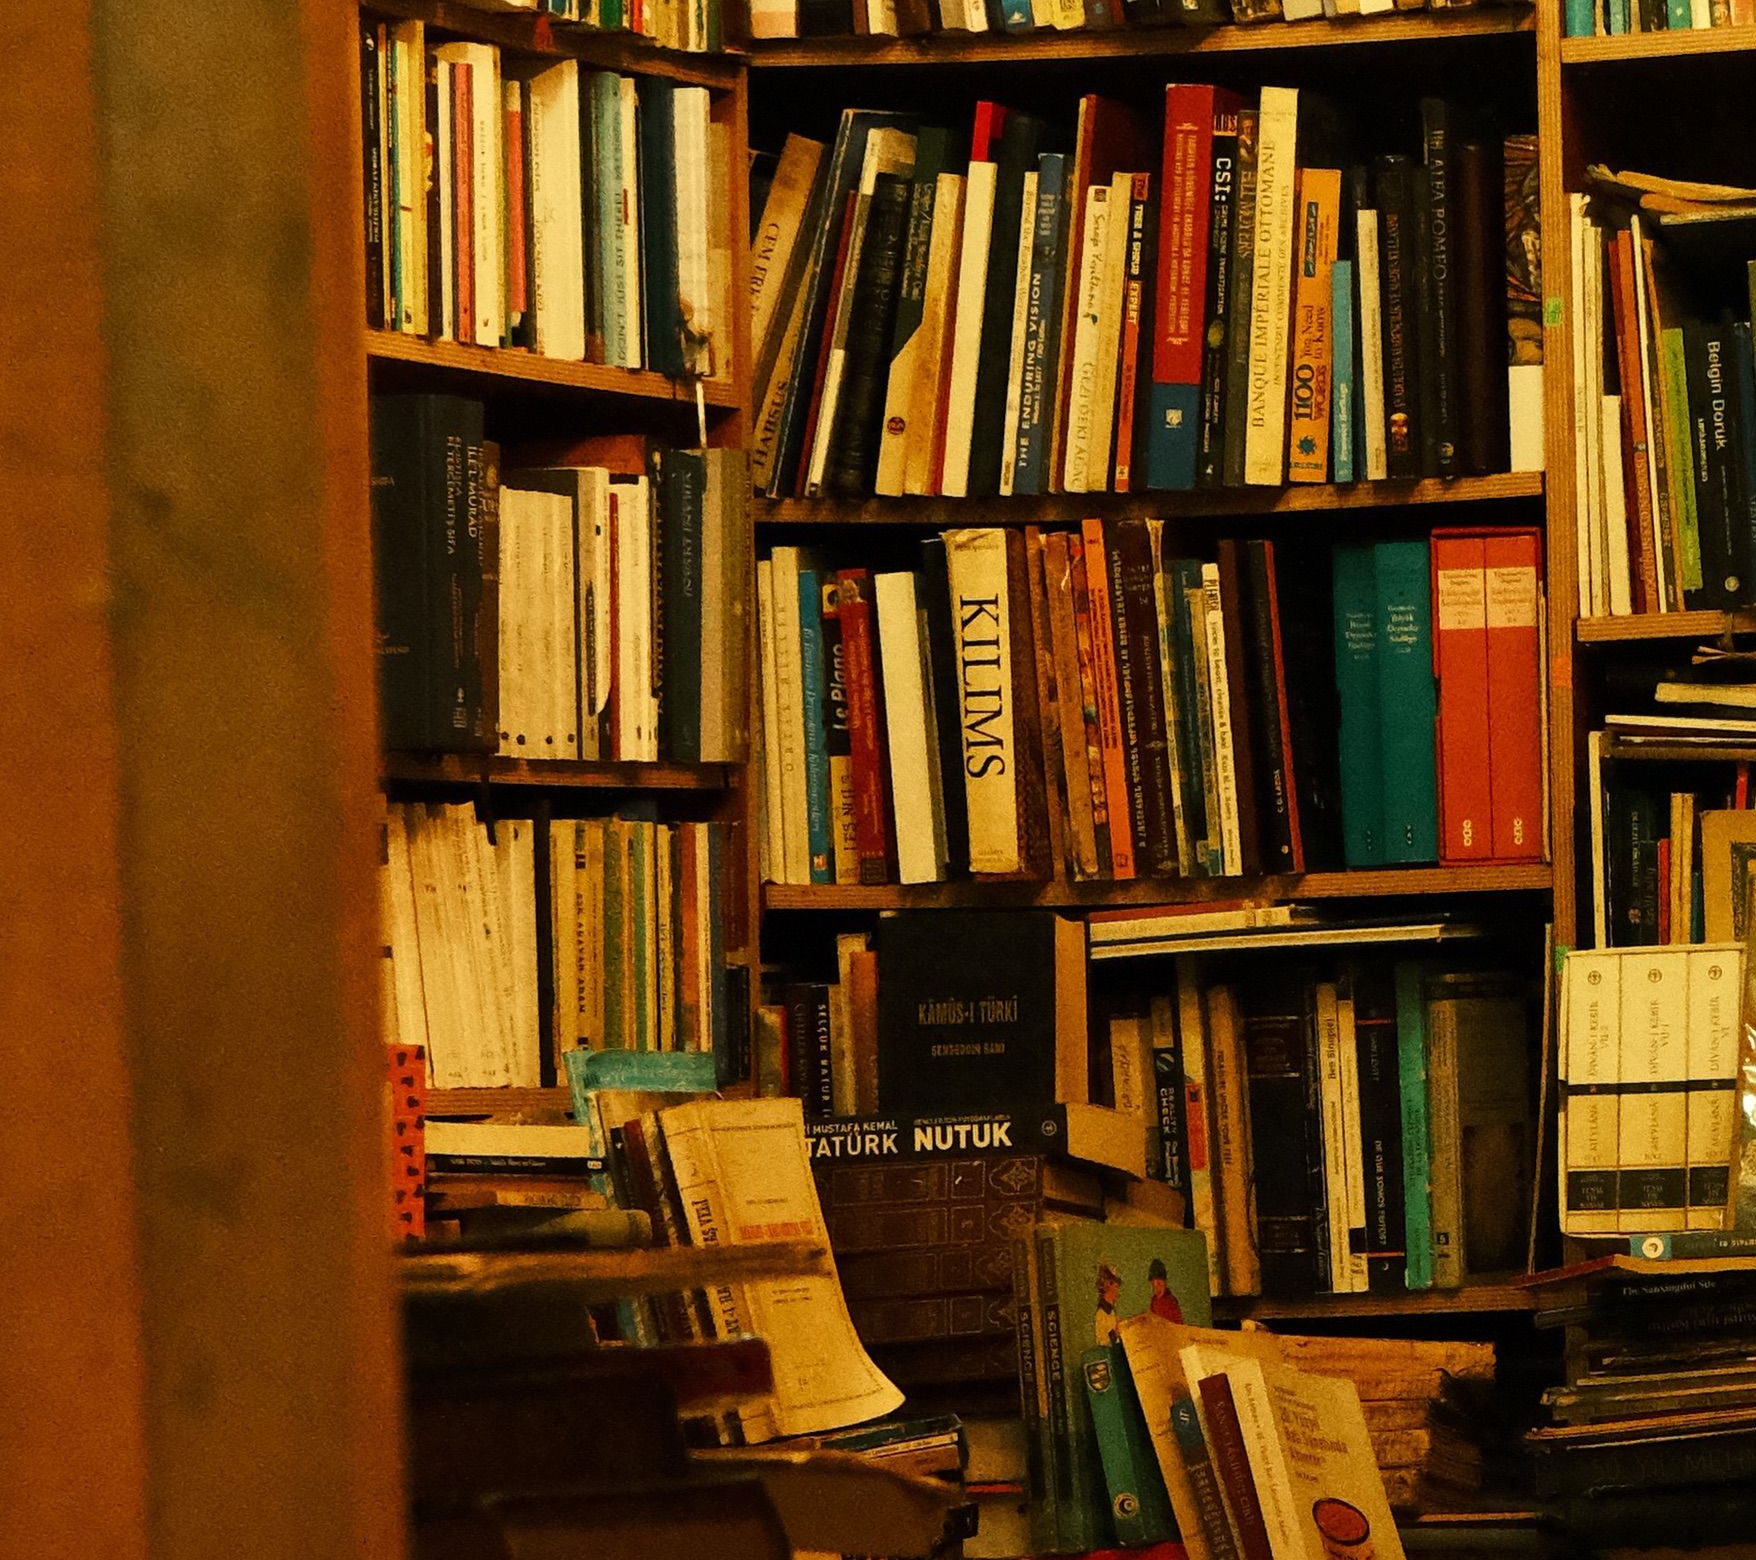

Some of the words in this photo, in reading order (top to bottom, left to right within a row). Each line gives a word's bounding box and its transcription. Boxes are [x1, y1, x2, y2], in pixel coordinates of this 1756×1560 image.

[1214, 157, 1231, 202] CSI:
[1258, 141, 1276, 242] OTTOMANE
[1431, 159, 1445, 201] ALFA
[1432, 207, 1447, 280] ROMEO
[1028, 272, 1042, 332] VISION
[1128, 281, 1139, 325] EXPERT
[1254, 248, 1272, 347] IMPÉRIALE
[1301, 304, 1314, 335] Need
[1022, 338, 1037, 429] ENDURING
[1251, 354, 1267, 428] BANQUE
[1294, 364, 1314, 420] 1100
[1707, 341, 1723, 393] Belgin
[1712, 399, 1728, 450] Doruk
[1018, 436, 1030, 467] THE
[830, 644, 846, 702] Piano
[959, 594, 1005, 779] KILIMS
[833, 708, 848, 730] Le
[804, 1129, 899, 1158] TATÜRK
[813, 1123, 861, 1134] MUSTAFA
[863, 1120, 898, 1131] KEMAL
[914, 1122, 1013, 1152] NUTUK
